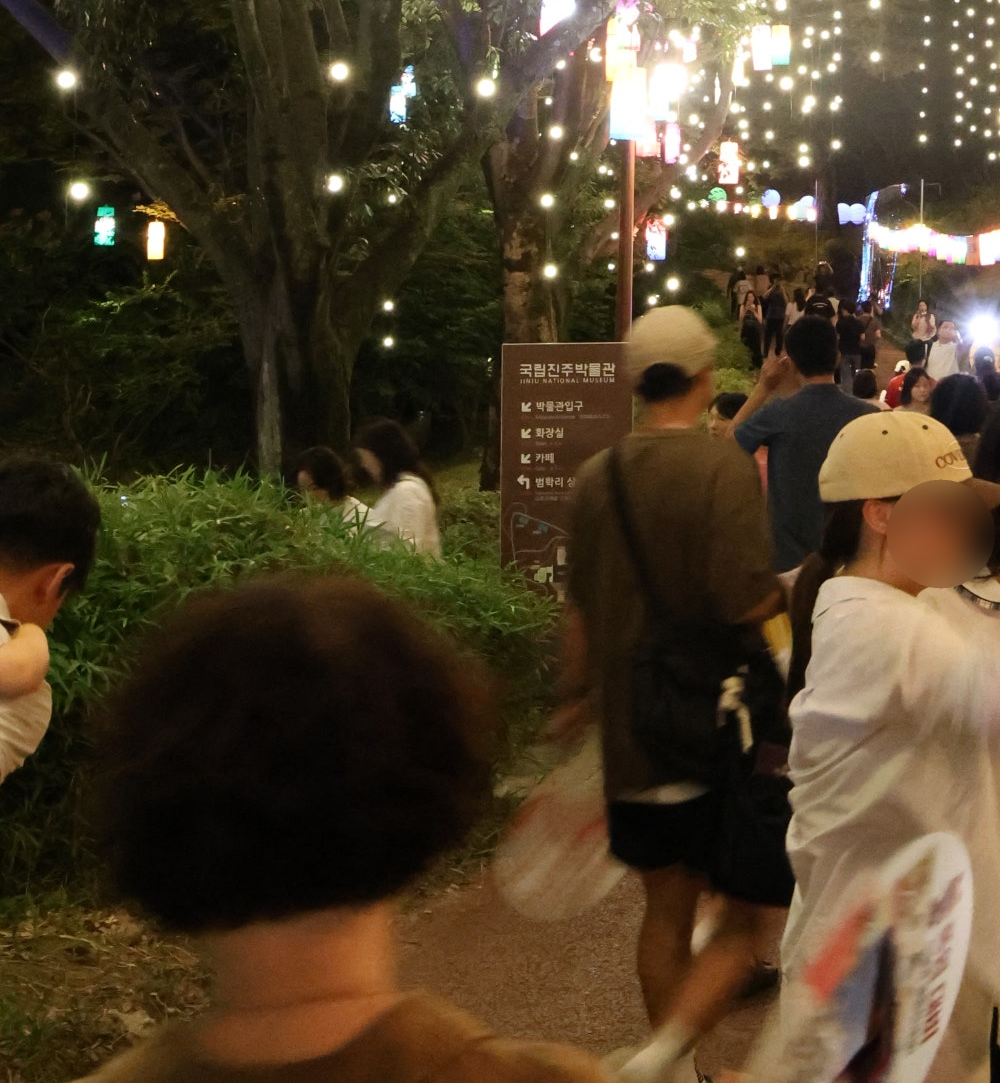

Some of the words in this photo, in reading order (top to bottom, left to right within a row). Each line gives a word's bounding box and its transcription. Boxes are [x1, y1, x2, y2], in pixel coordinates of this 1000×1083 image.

[519, 362, 616, 378] 국립진주박물관
[535, 401, 584, 412] 박물관입구
[535, 427, 564, 439] 화장실
[535, 452, 555, 464] 카페
[535, 477, 564, 488] 범학리
